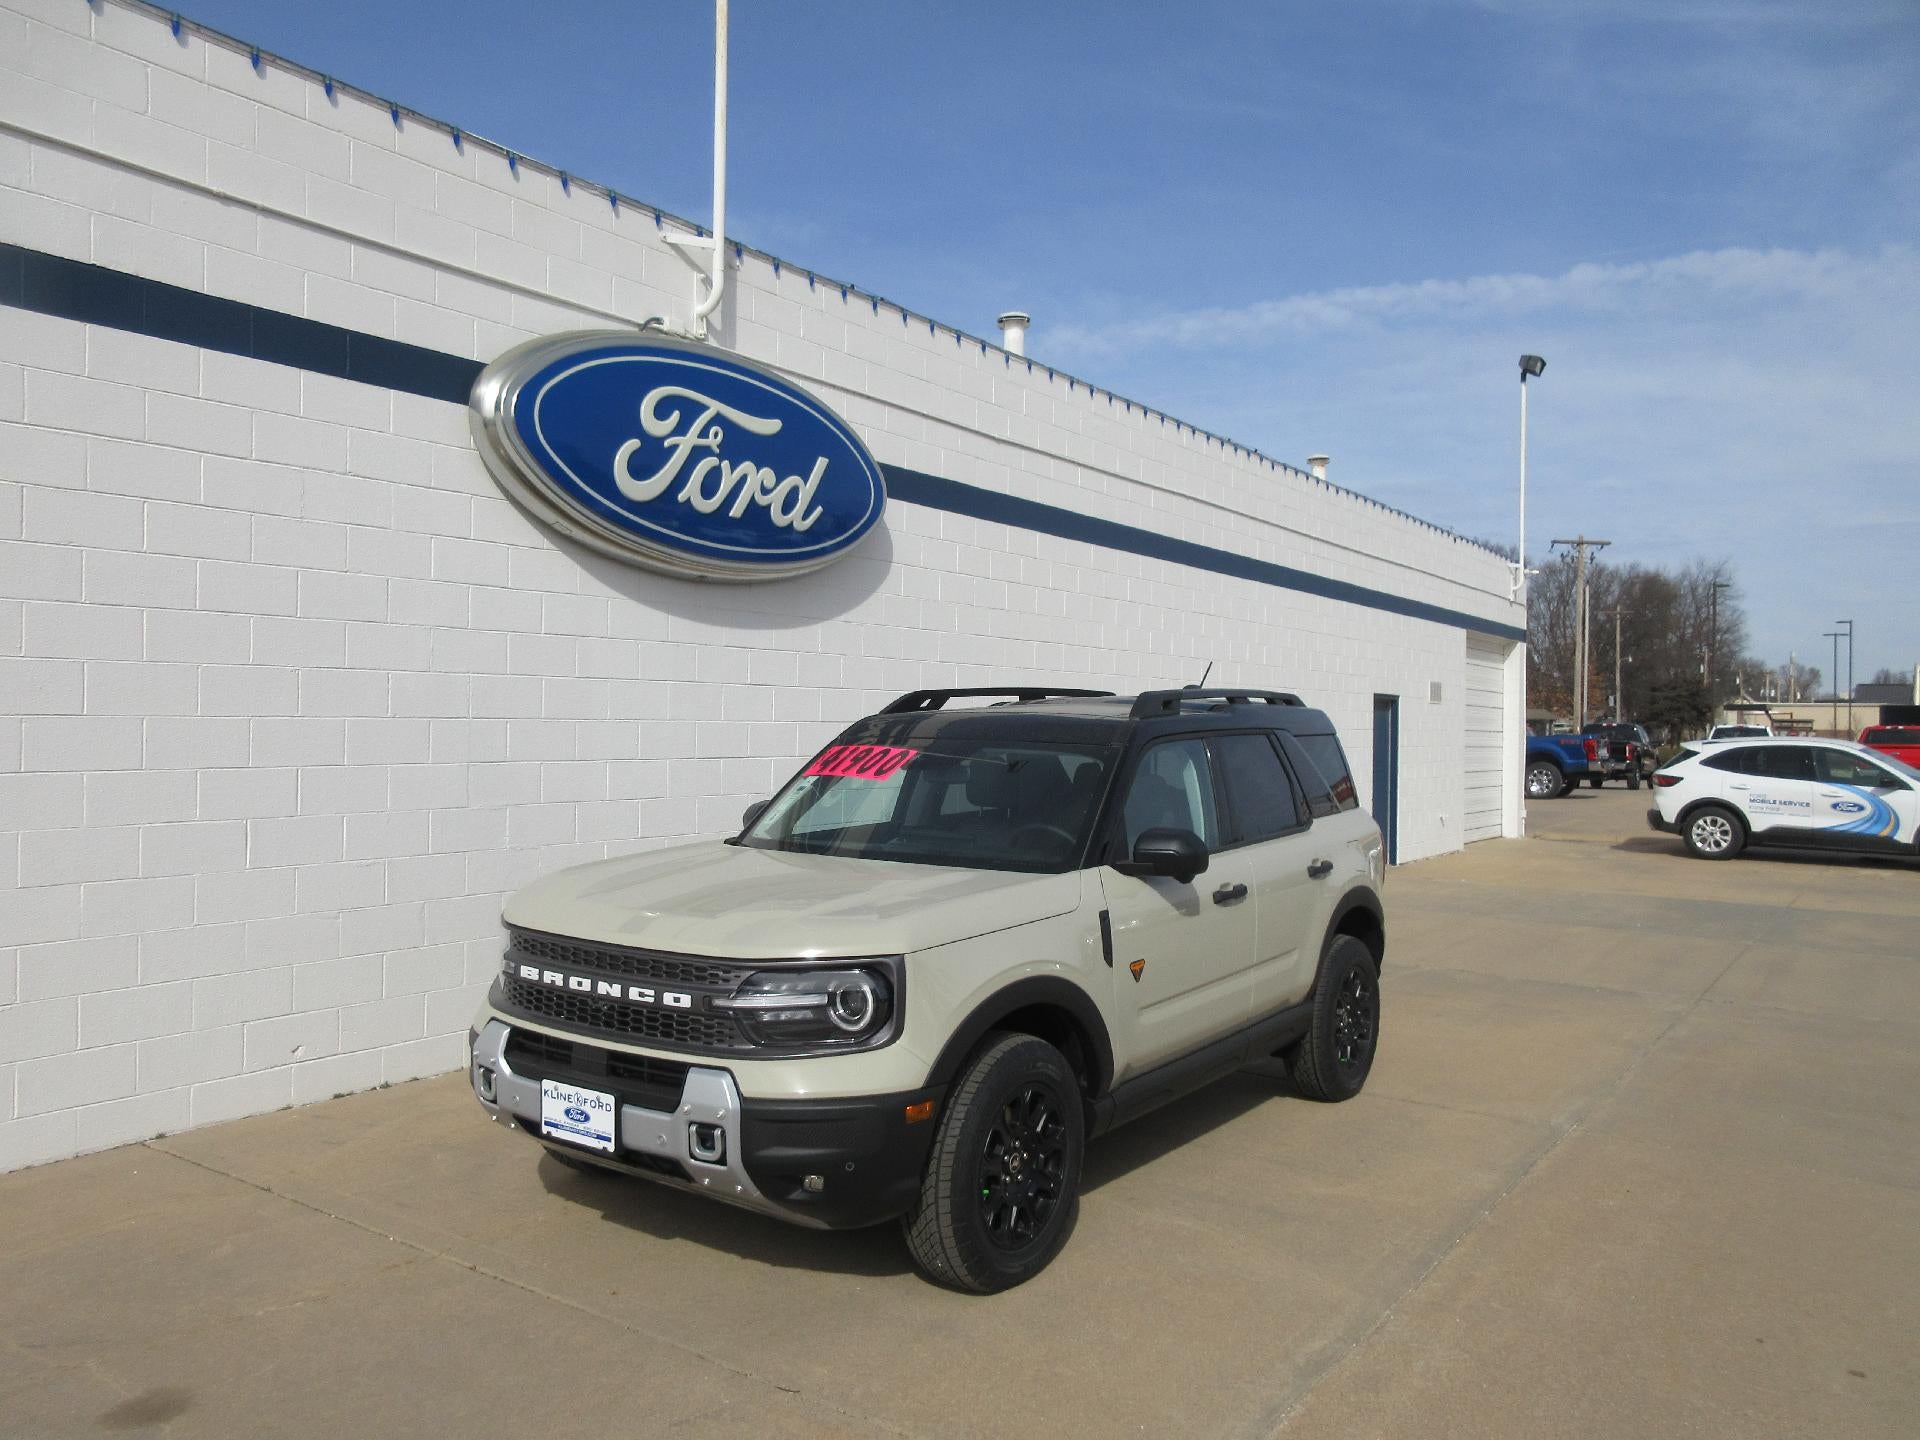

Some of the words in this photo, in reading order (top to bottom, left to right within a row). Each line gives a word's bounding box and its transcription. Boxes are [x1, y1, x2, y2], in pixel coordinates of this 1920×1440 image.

[613, 386, 829, 531] Ford
[1779, 800, 1811, 808] SERVICE
[520, 964, 692, 1008] BRONCO
[543, 1088, 573, 1103] KLINE
[583, 1098, 612, 1112] FORD
[567, 1108, 587, 1121] Ford
